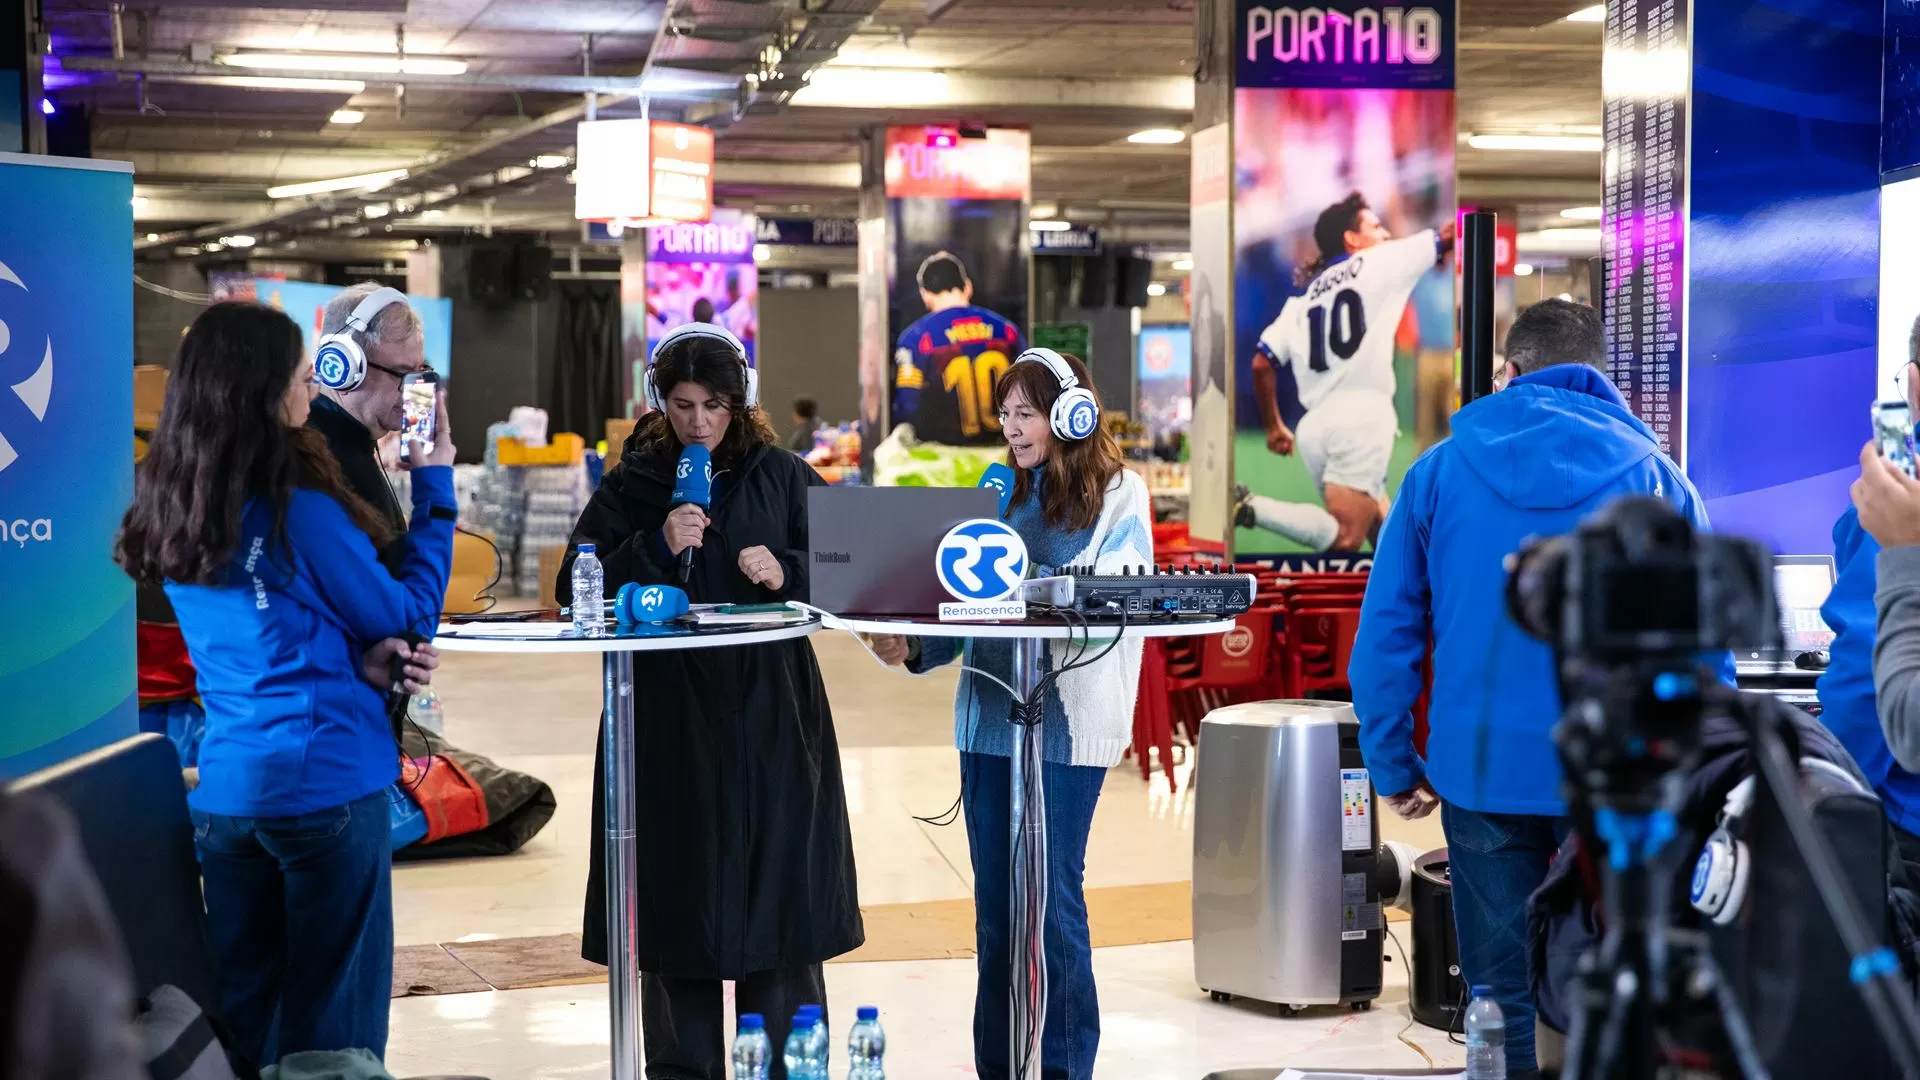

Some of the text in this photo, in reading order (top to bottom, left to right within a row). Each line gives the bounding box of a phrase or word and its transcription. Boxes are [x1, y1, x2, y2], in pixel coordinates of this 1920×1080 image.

[1246, 6, 1442, 65] PORTA10
[944, 322, 994, 343] MESSI
[1306, 288, 1367, 373] 10
[942, 349, 1010, 438] 10
[814, 552, 851, 564] ThinkBook
[943, 606, 1023, 617] Renascença
